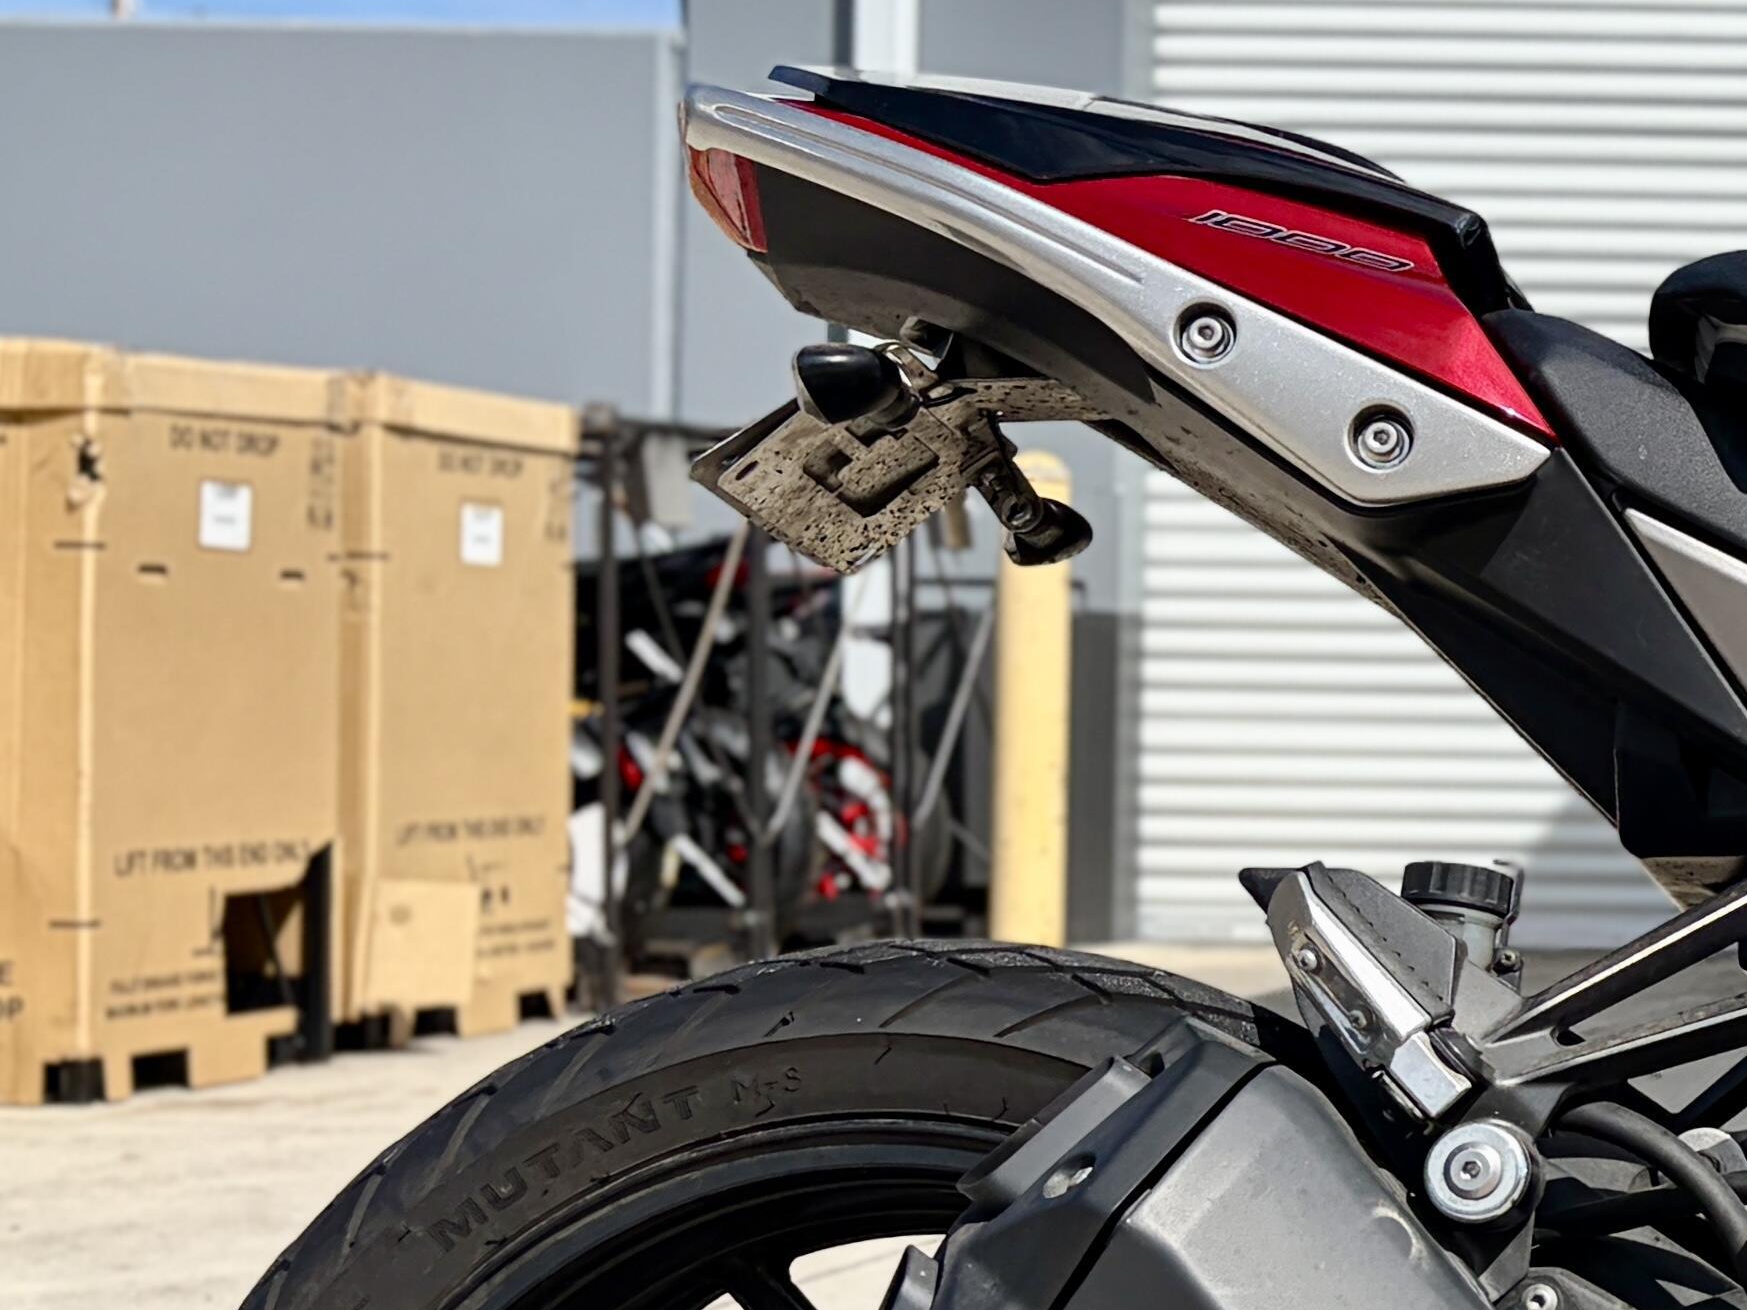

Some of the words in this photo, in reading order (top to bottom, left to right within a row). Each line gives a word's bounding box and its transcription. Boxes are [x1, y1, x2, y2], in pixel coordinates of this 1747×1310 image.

[169, 424, 195, 450] DO
[199, 426, 231, 452] NOT
[236, 427, 280, 456] DROP
[114, 848, 148, 876] LIFT
[152, 846, 197, 873] FROM
[425, 1085, 699, 1253] MUTANT
